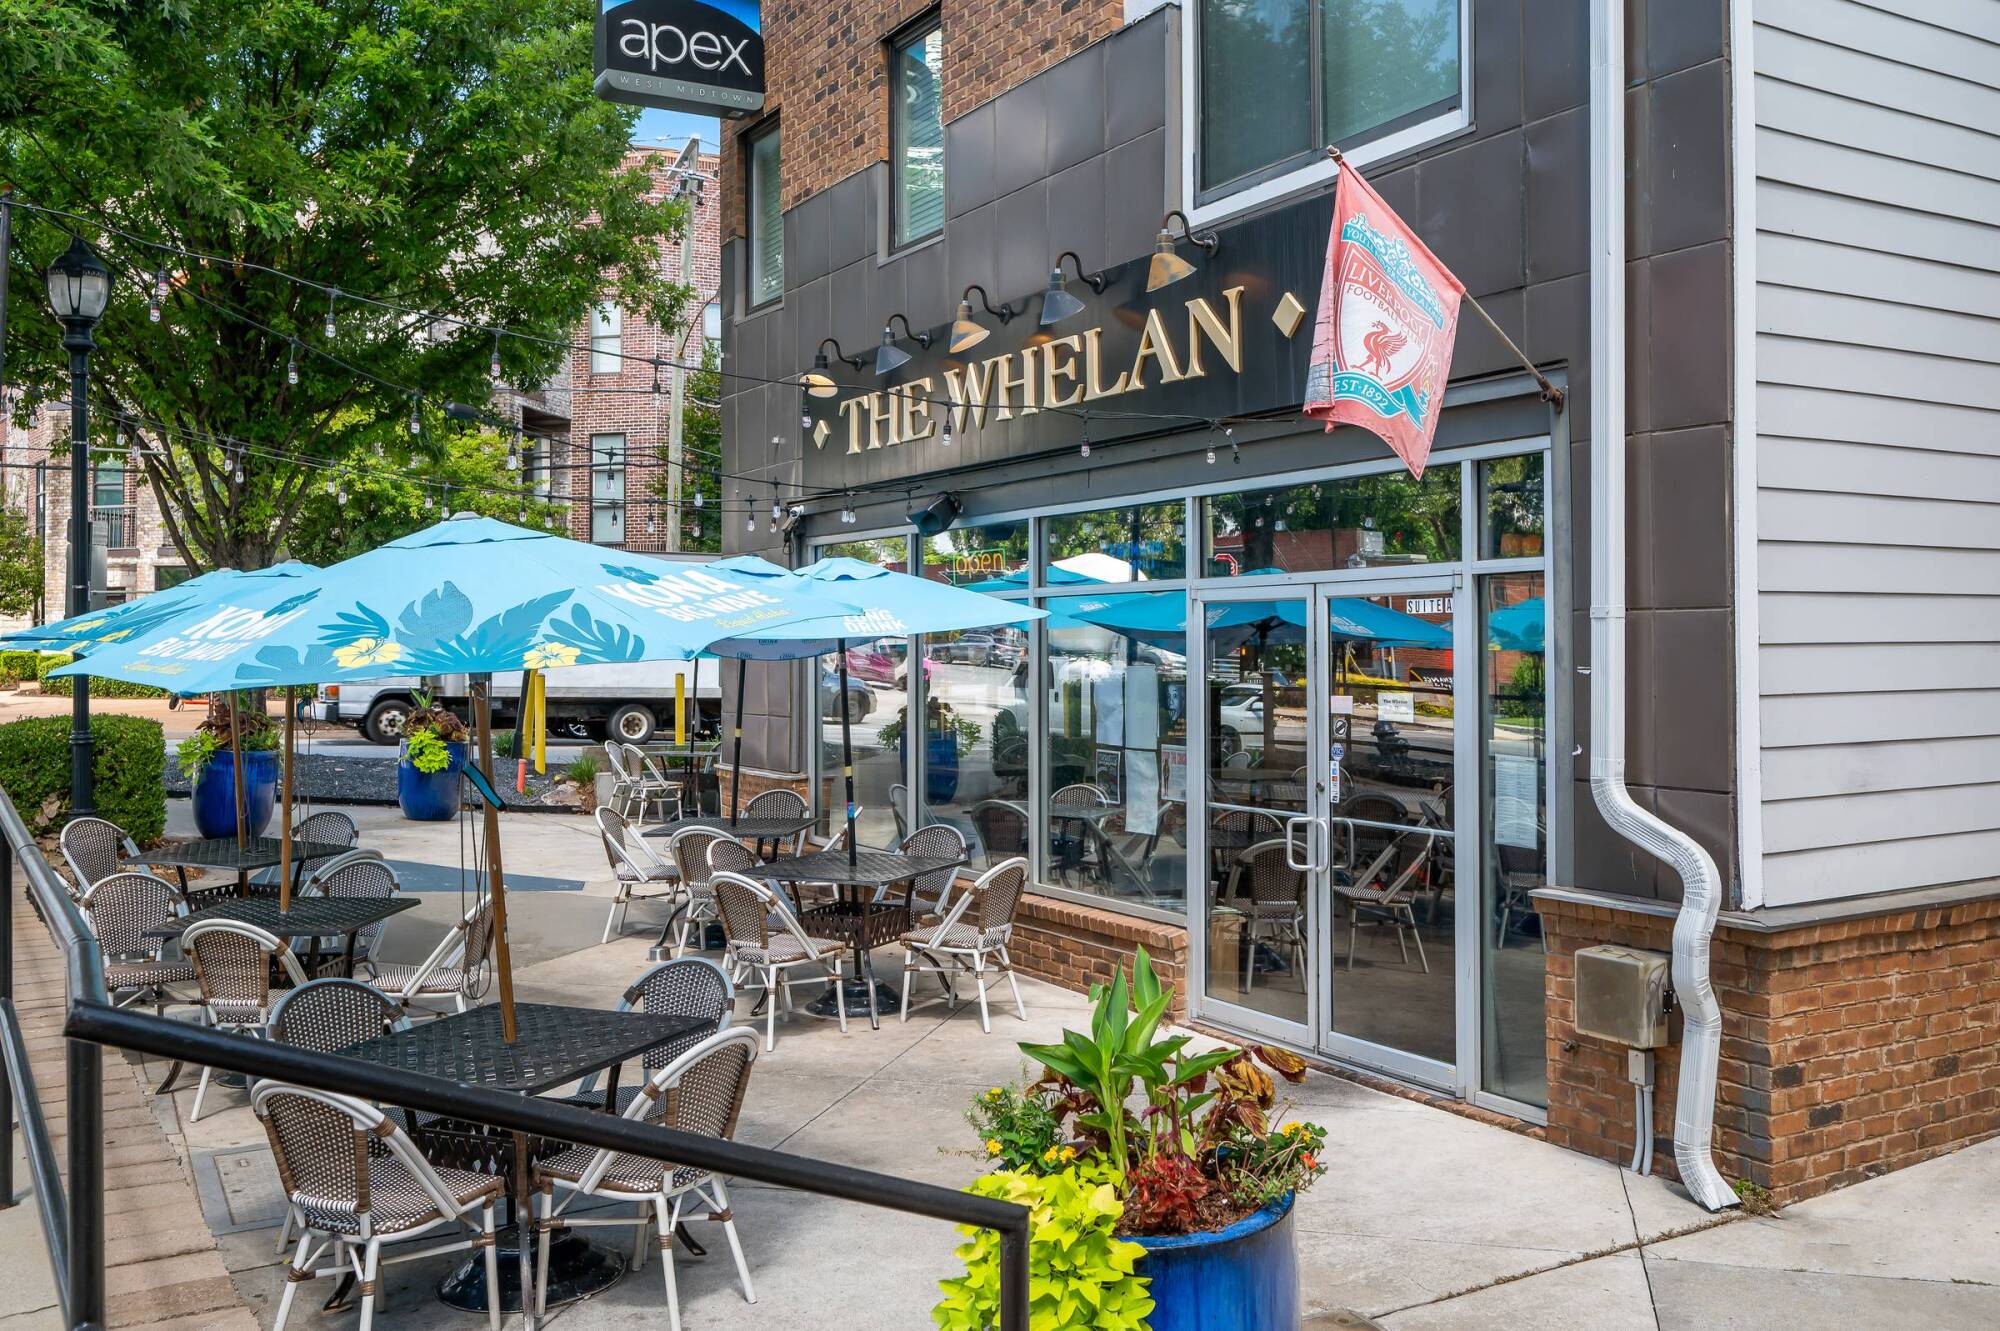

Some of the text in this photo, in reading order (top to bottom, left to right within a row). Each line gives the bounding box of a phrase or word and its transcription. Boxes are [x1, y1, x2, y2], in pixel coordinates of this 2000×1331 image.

[619, 18, 753, 76] apex
[620, 77, 753, 104] WEST MIDTOWN
[1348, 262, 1424, 337] LIVERPOOL
[840, 286, 1244, 455] THE WHELAN
[956, 553, 1003, 579] open
[597, 570, 744, 608] KONA
[1408, 599, 1441, 613] SUITE
[844, 619, 908, 633] DRINK
